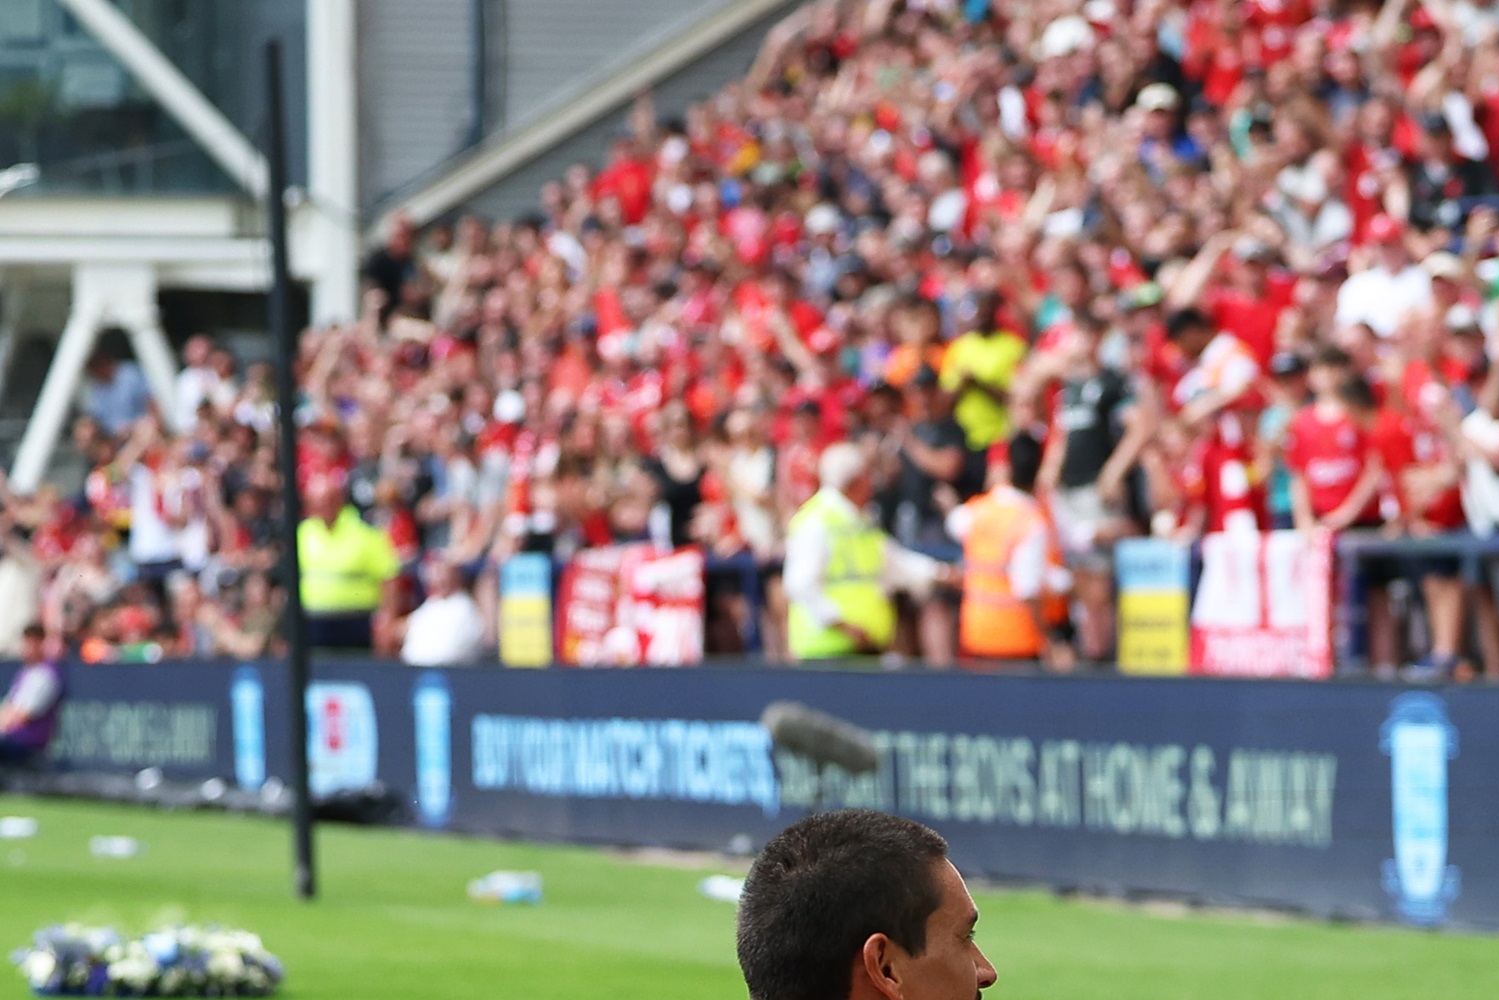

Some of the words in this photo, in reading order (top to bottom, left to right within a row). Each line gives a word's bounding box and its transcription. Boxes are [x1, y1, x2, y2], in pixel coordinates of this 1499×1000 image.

[896, 731, 950, 820] THE
[1038, 739, 1081, 828] AT
[1082, 742, 1187, 838] HOME
[1187, 743, 1222, 840] &
[1222, 748, 1339, 848] AWAY
